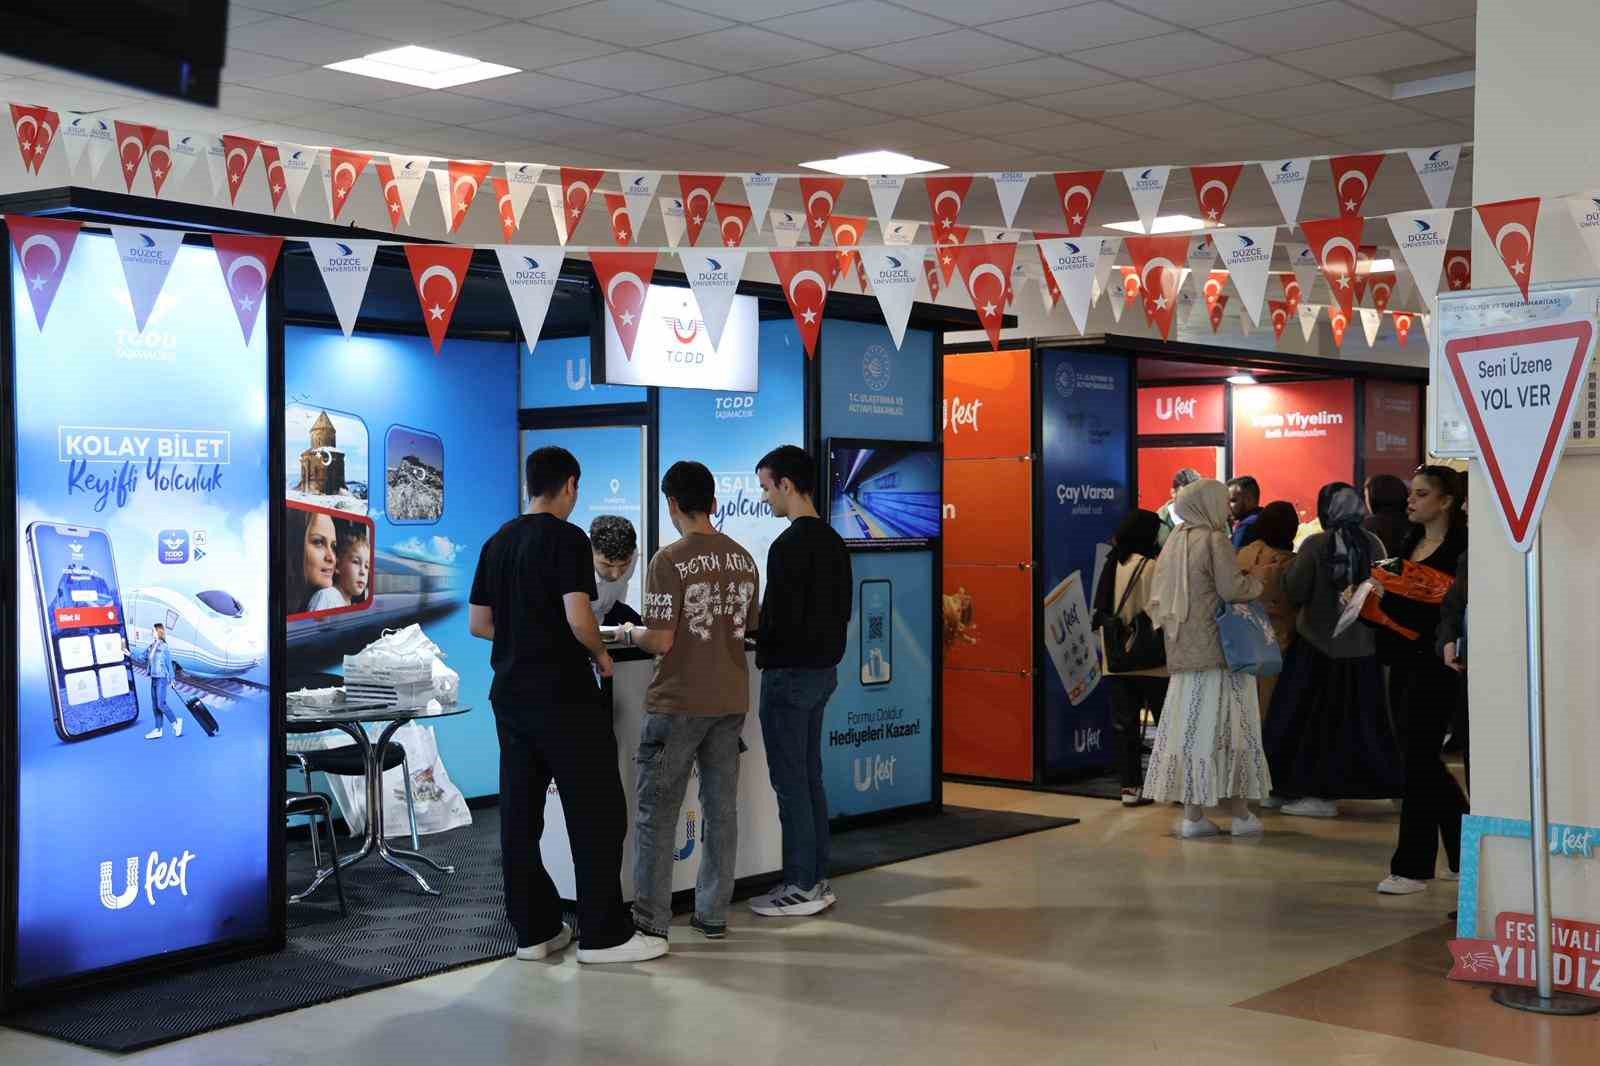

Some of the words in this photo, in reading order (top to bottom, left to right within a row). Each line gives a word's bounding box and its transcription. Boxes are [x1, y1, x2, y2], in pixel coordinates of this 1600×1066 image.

[1408, 230, 1439, 242] DÜZCE
[130, 246, 162, 258] DÜZCE
[1232, 246, 1263, 258] DÜZCE
[329, 256, 361, 266] DÜZCE
[1058, 254, 1089, 265] DÜZCE
[516, 269, 547, 280] DÜZCE
[698, 271, 729, 281] DÜZCE
[879, 269, 910, 279] DÜZCE
[666, 350, 705, 364] TCDD
[1478, 358, 1507, 379] Seni
[1510, 352, 1552, 376] Üzene
[715, 396, 754, 409] TCDD
[1481, 387, 1513, 411] YOL
[1517, 383, 1551, 409] VER
[1287, 411, 1344, 429] Yiyelim
[66, 435, 151, 456] KOLAY
[158, 433, 224, 458] BİLET
[68, 459, 138, 512] Keyifli
[146, 457, 223, 493] Yolculuk
[1056, 484, 1080, 505] Çay
[1081, 484, 1115, 500] Varsa
[847, 711, 876, 726] Formu
[877, 707, 905, 721] Doldur
[829, 725, 884, 748] Hediyeleri
[885, 720, 921, 738] Kazan!
[1505, 920, 1600, 953] FESİVALİ
